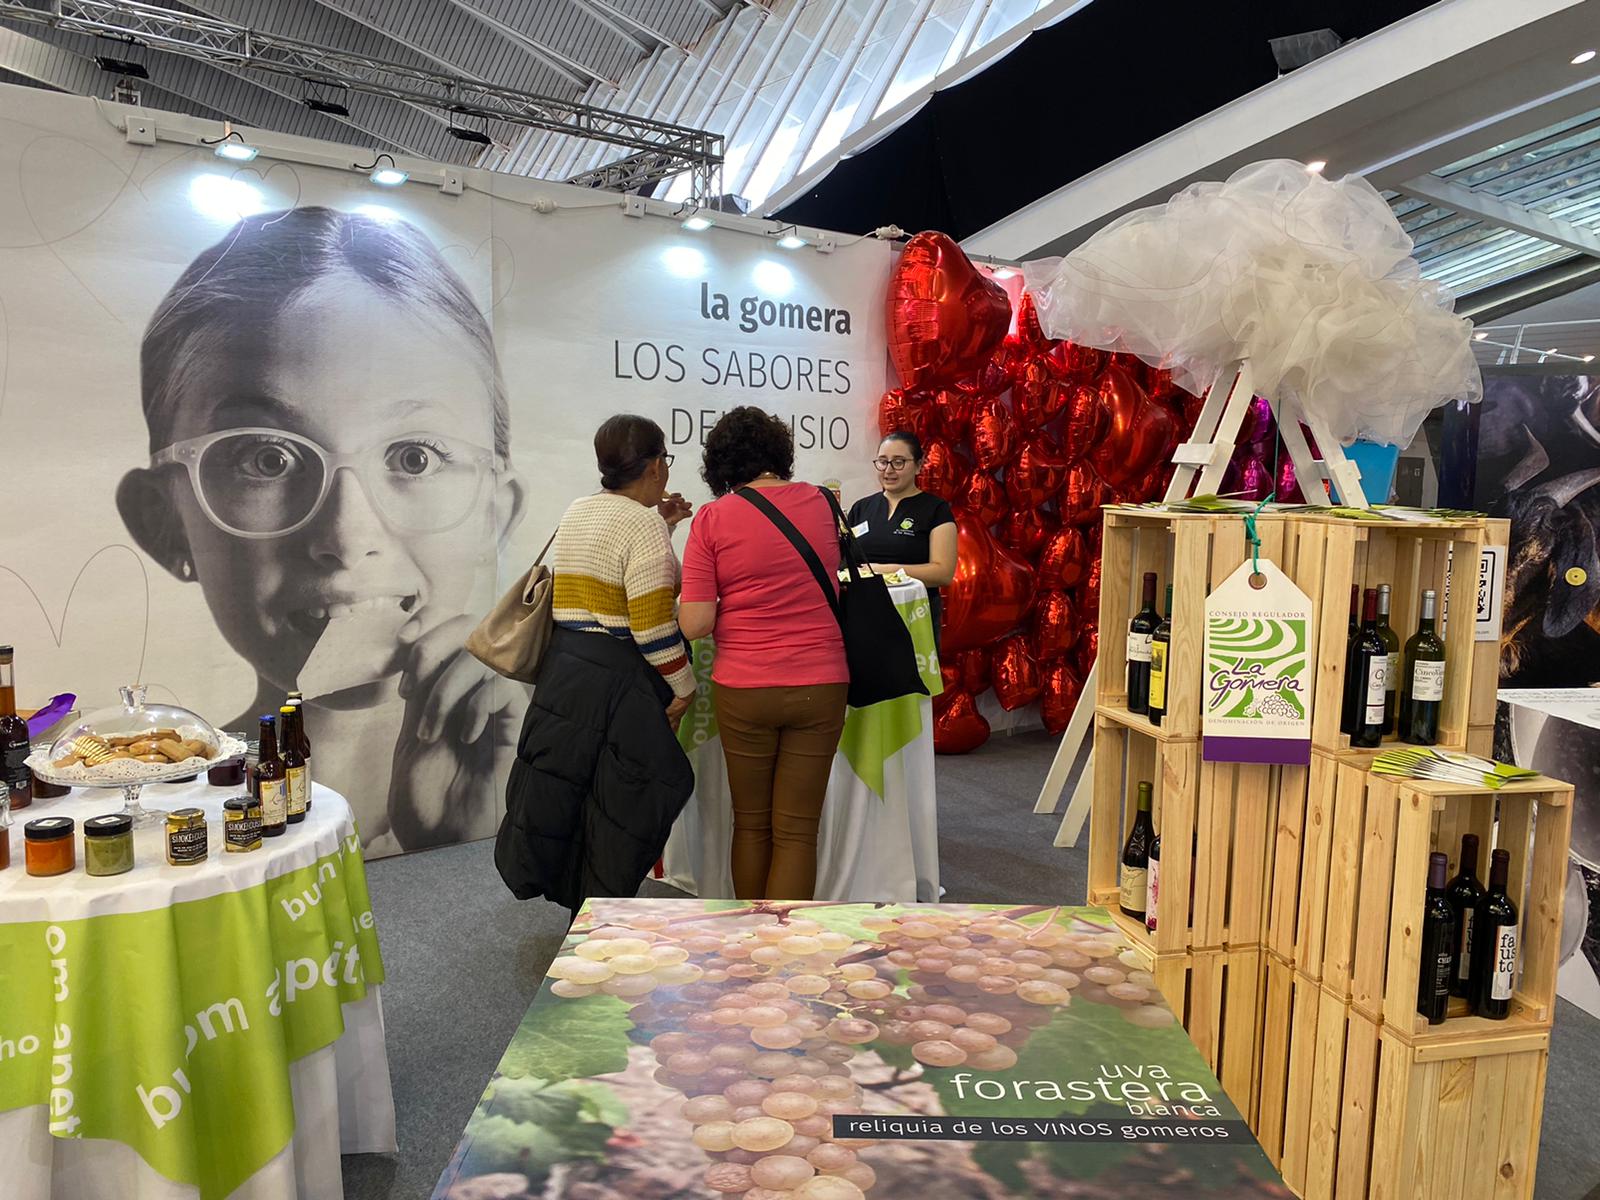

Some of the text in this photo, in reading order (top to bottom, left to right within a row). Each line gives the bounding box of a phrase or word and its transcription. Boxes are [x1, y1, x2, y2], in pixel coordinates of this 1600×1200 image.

[701, 282, 851, 335] la gomera
[614, 340, 851, 395] LOS SABORES
[671, 408, 726, 447] DE
[1209, 657, 1305, 708] La Gomera
[950, 1073, 1213, 1102] forastera
[1101, 1064, 1171, 1079] uva
[1127, 1101, 1222, 1117] blanca
[849, 1119, 1230, 1140] reliquia de los VINOS gomeros
